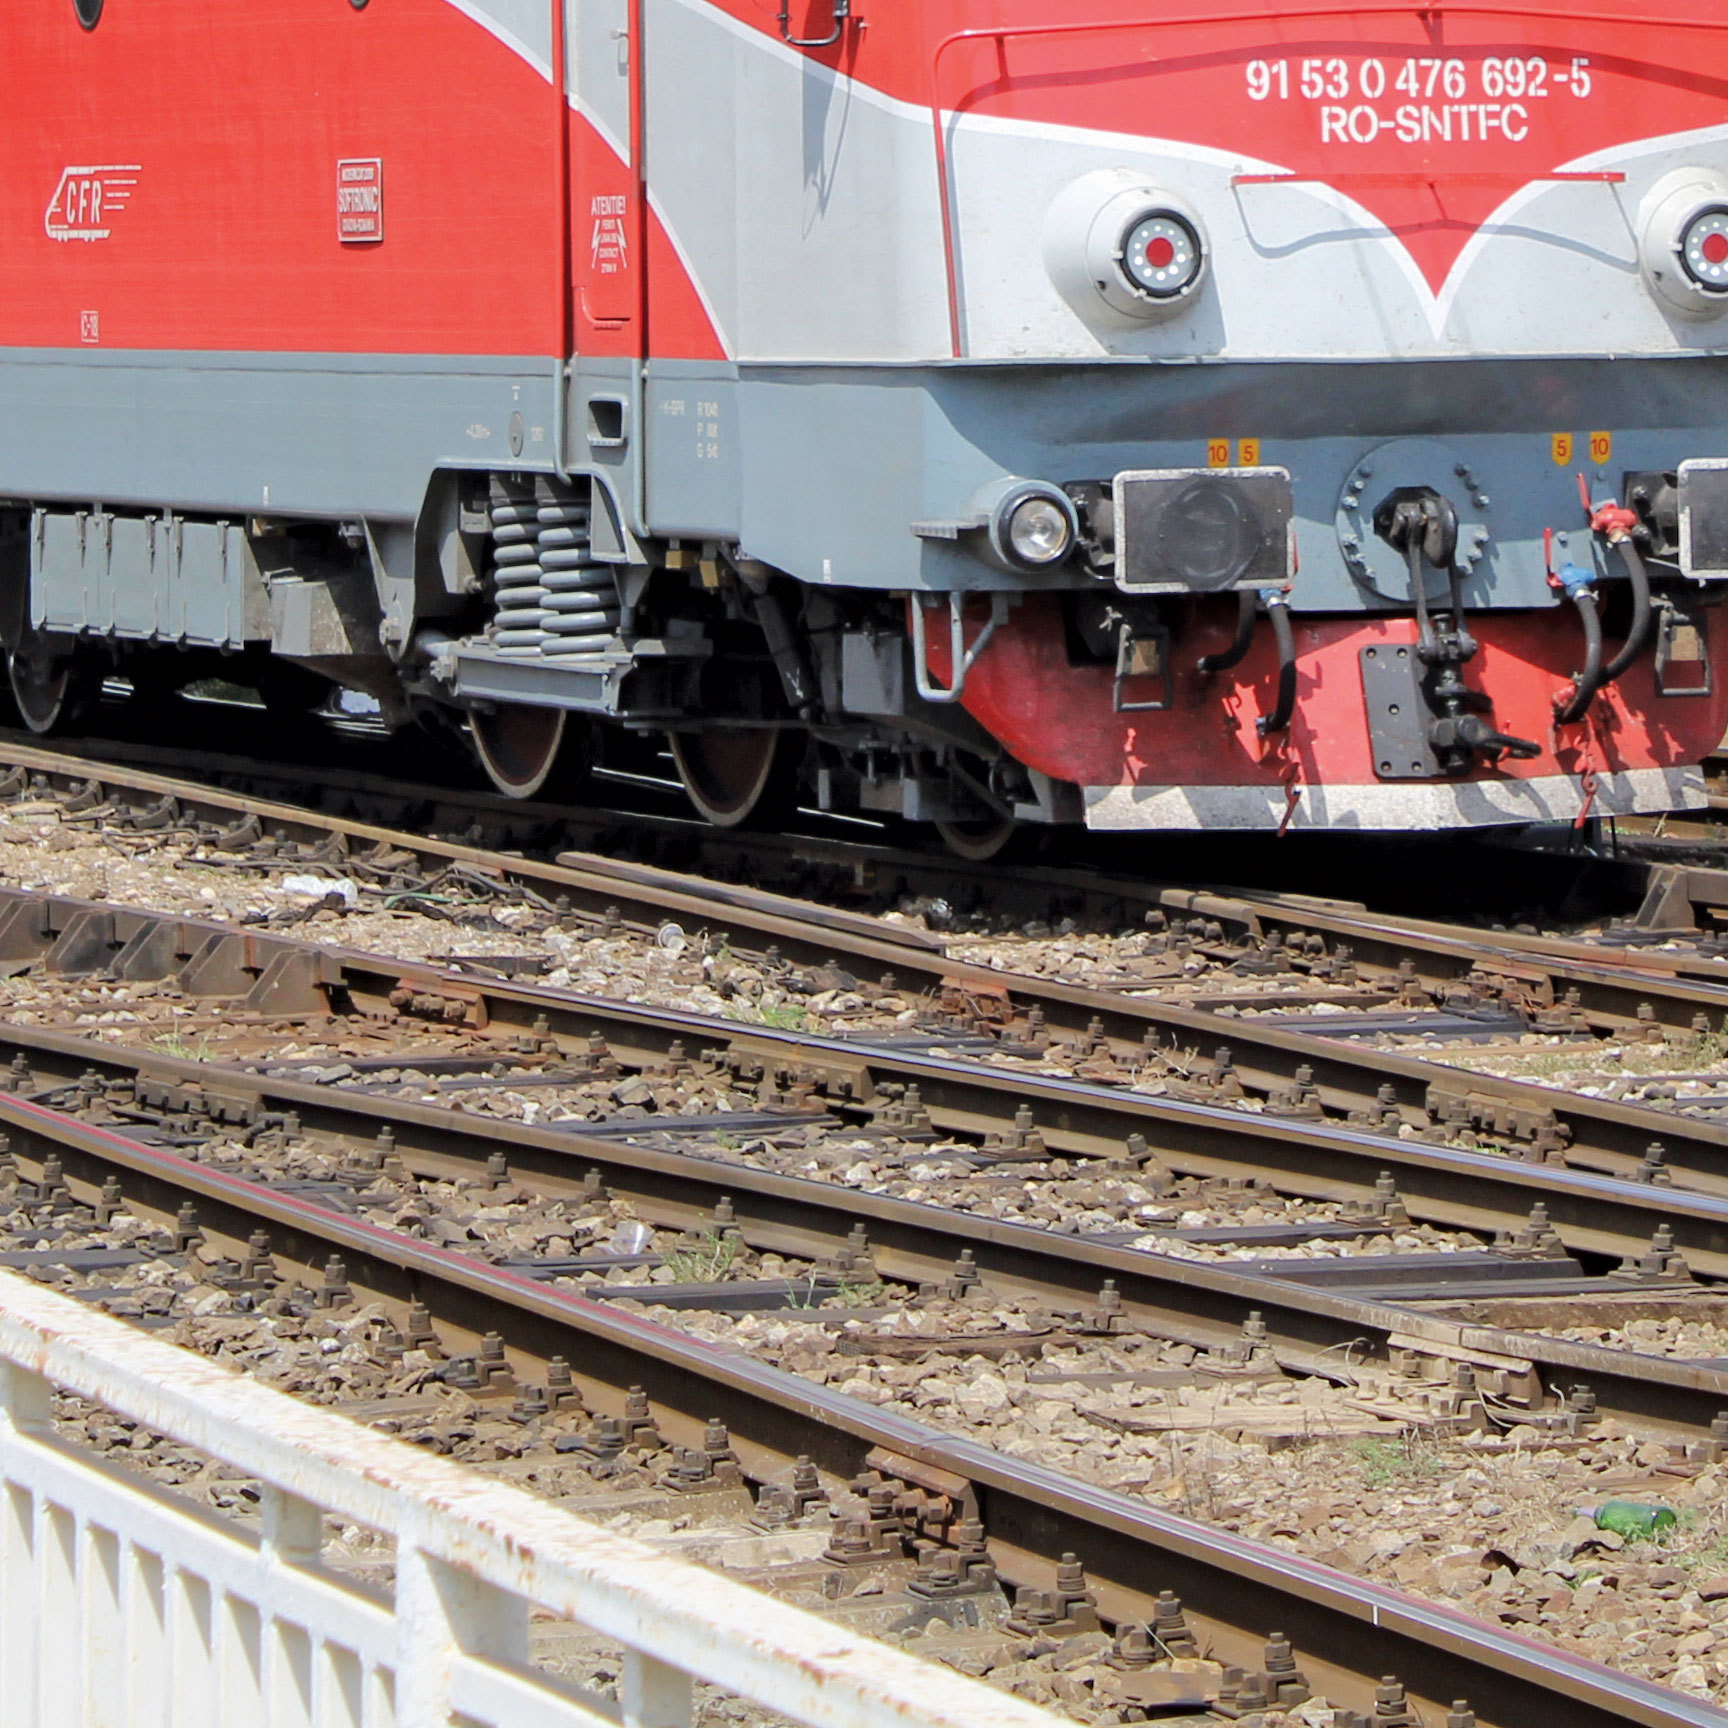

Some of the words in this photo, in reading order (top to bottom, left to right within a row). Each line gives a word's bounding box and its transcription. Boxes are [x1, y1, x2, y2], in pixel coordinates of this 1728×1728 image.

[1245, 59, 1289, 101] 91
[1300, 58, 1350, 100] 53
[1360, 59, 1385, 99] 0
[1395, 58, 1466, 99] 476
[1481, 56, 1592, 99] 692-5
[1321, 103, 1529, 144] RO-SNTFC
[66, 180, 102, 224] CFR
[1209, 444, 1228, 463] 10
[1243, 445, 1254, 462] 5
[1557, 439, 1567, 457] 5
[1590, 438, 1609, 456] 10
